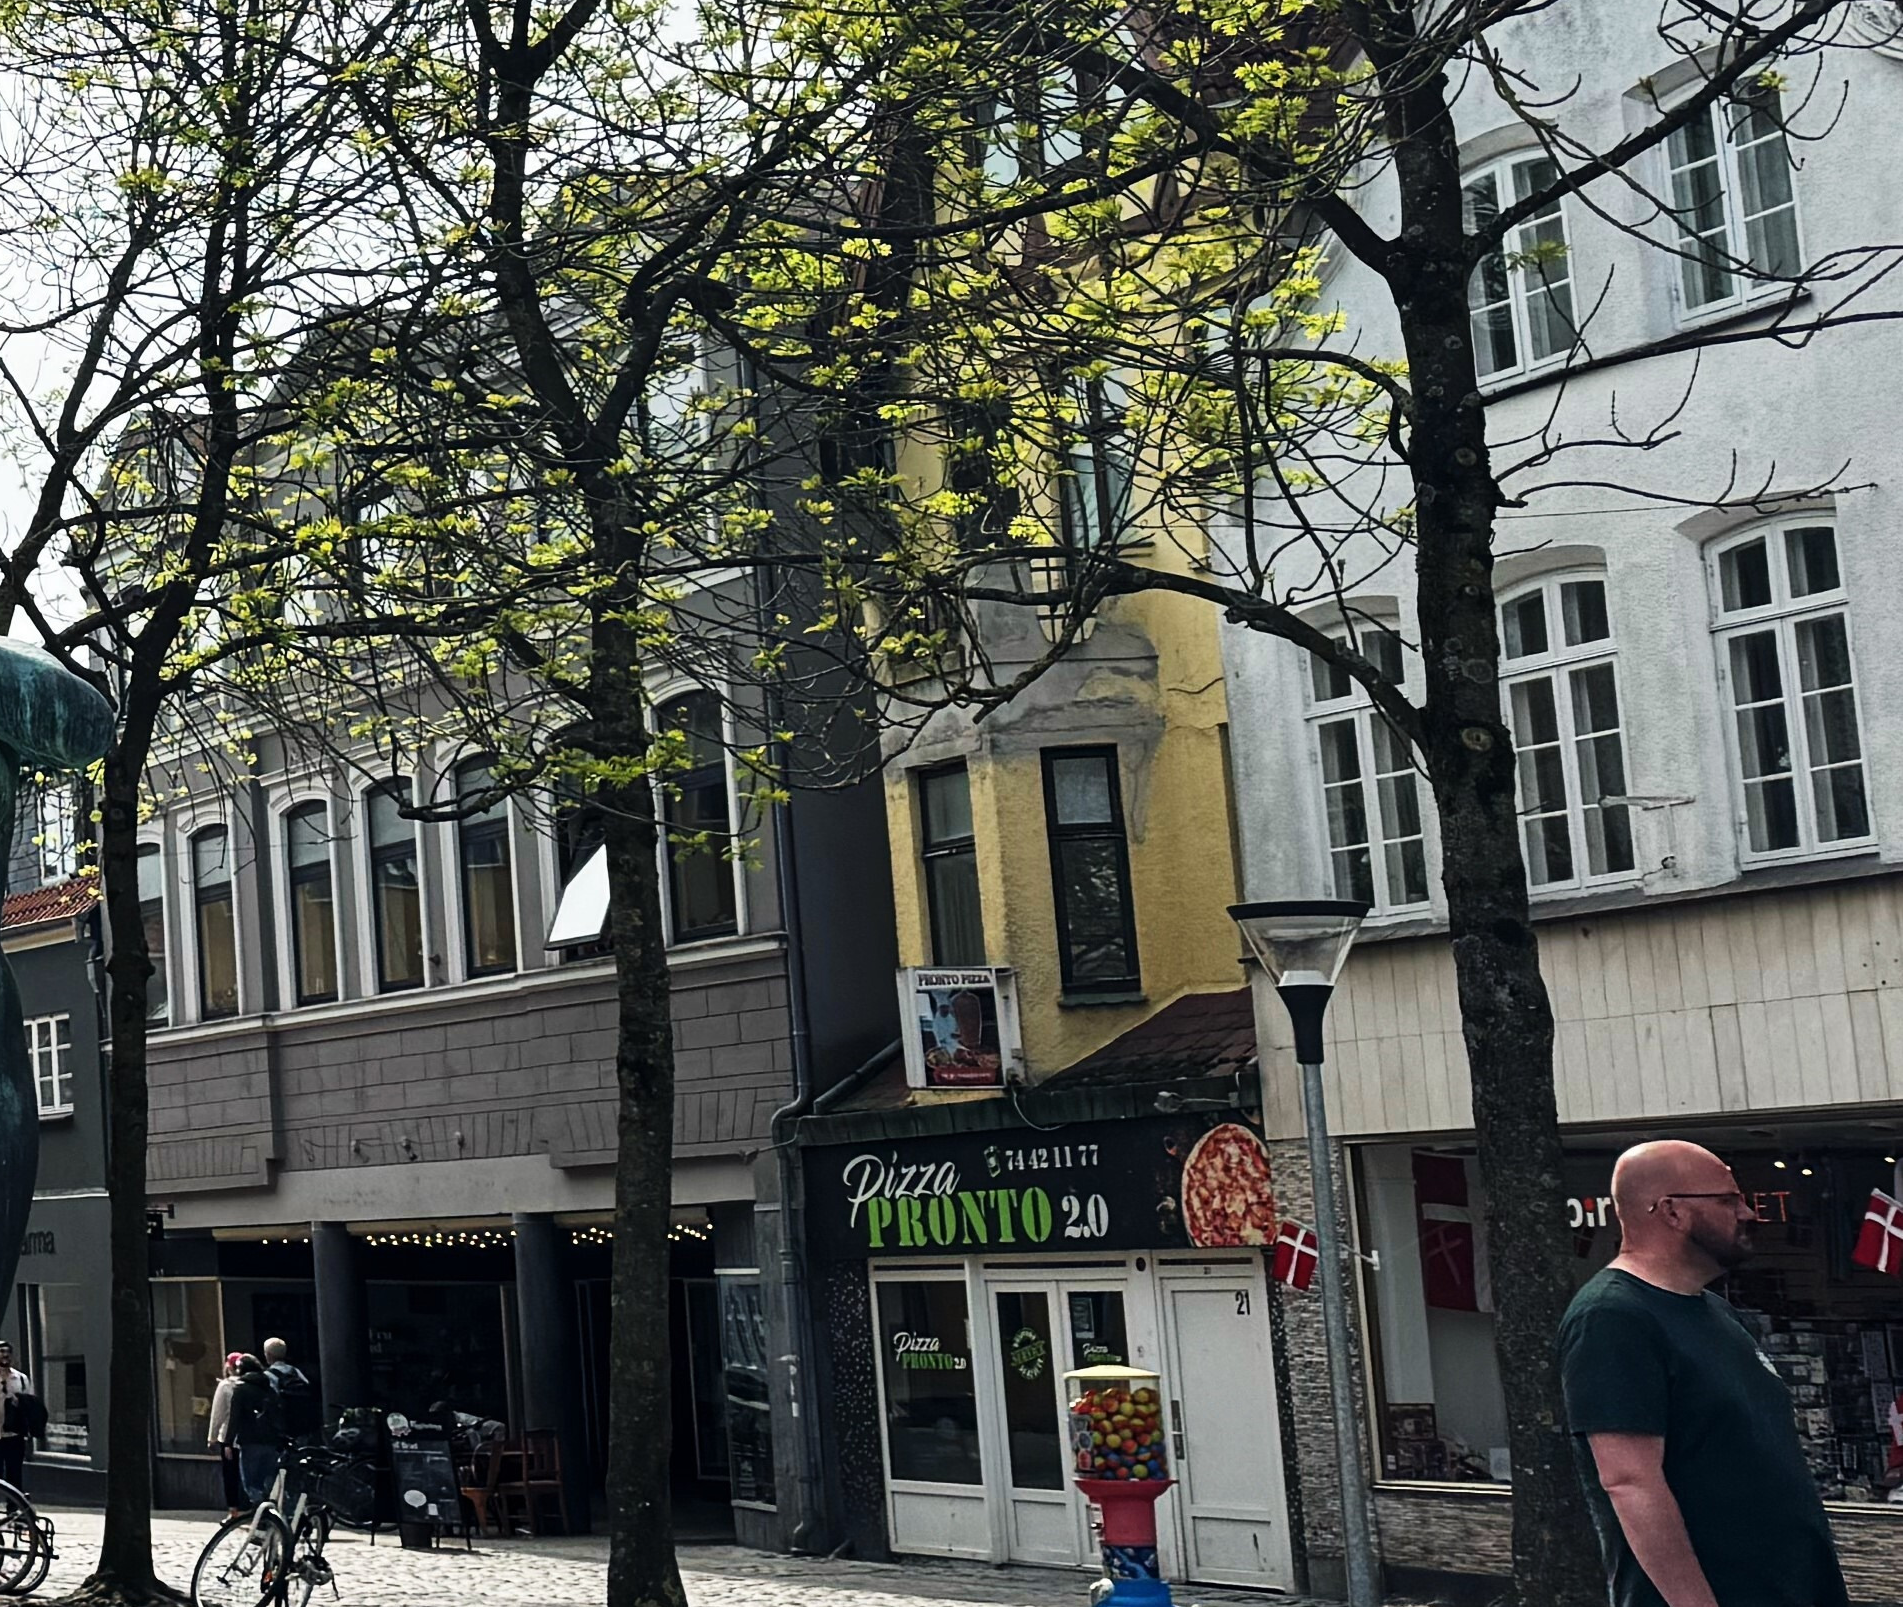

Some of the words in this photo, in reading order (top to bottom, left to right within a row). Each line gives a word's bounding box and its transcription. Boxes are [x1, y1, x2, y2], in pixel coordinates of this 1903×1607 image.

[918, 973, 960, 986] PRONTO
[961, 973, 991, 985] PIZZA
[1005, 1149, 1024, 1170] 74
[1028, 1148, 1049, 1169] 42
[1053, 1146, 1072, 1168] 11
[1078, 1144, 1098, 1166] 77
[843, 1150, 960, 1228] Pizza
[867, 1187, 1052, 1247] PRONTO
[1061, 1193, 1109, 1238] 2.0
[1236, 1290, 1250, 1315] 21
[893, 1331, 940, 1362] Pizza
[901, 1353, 953, 1370] PRONTO
